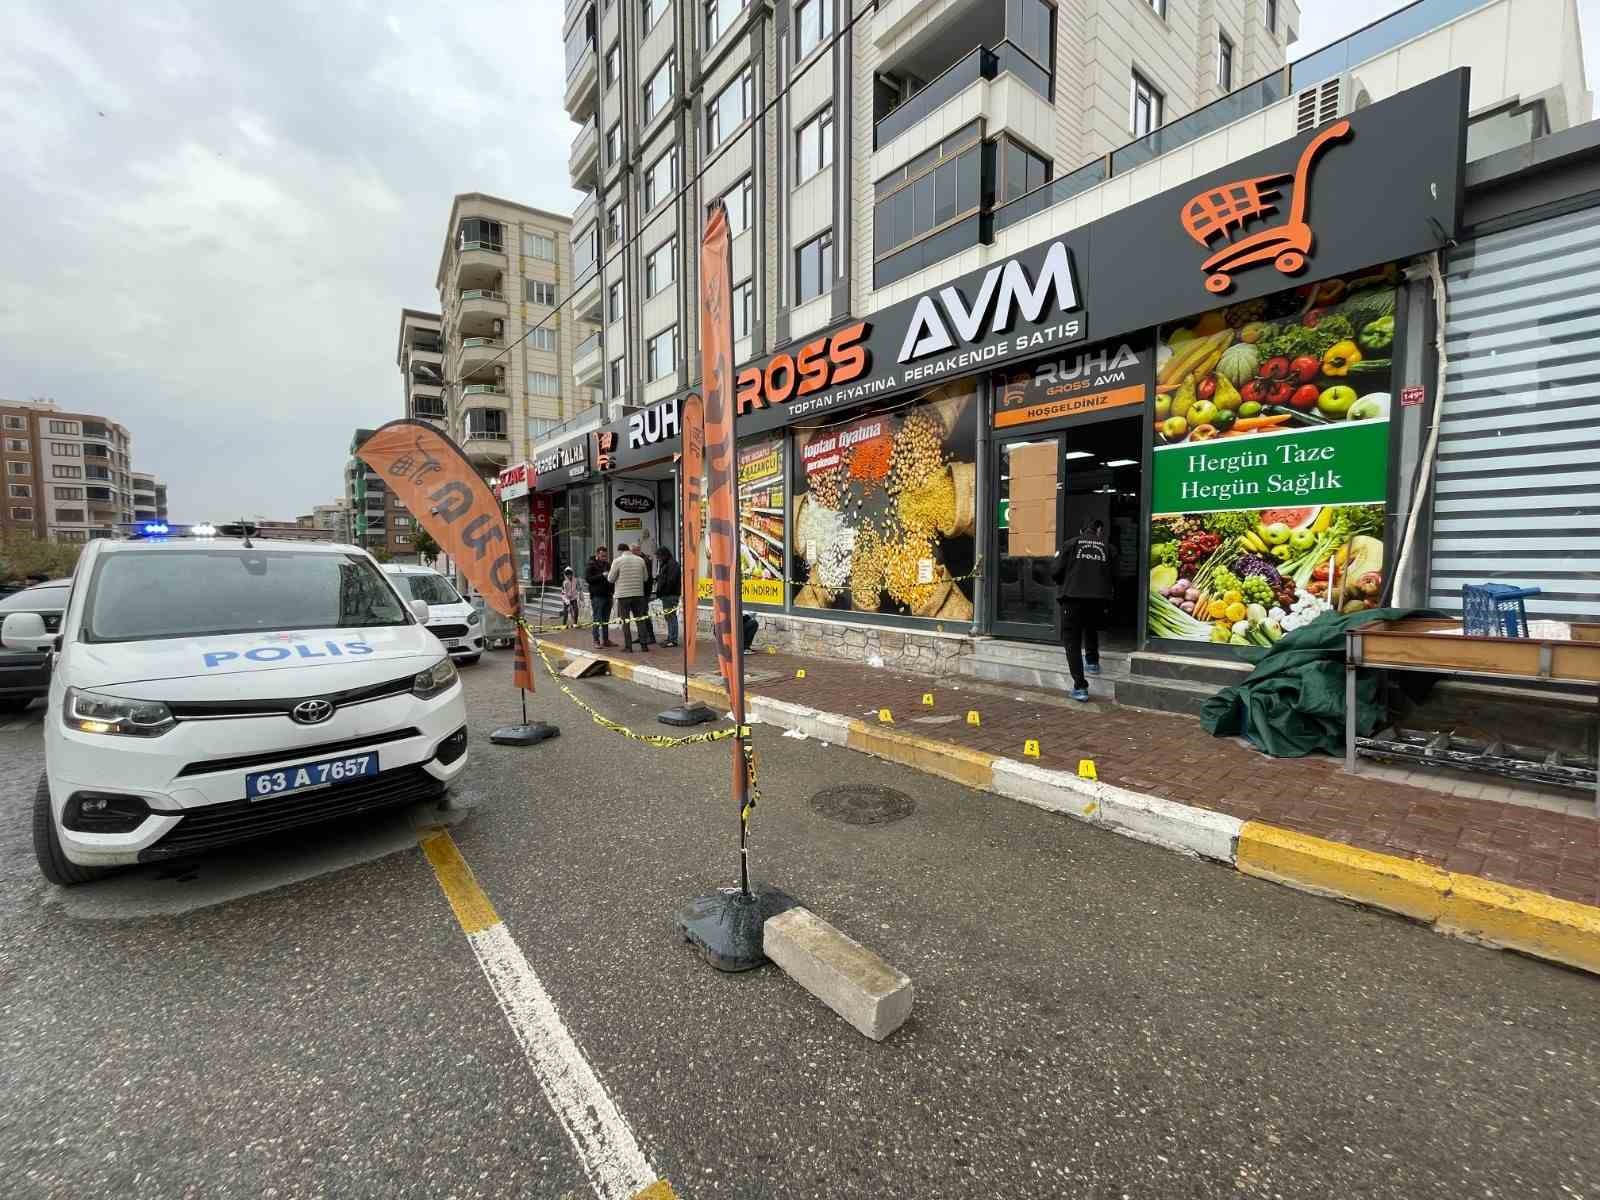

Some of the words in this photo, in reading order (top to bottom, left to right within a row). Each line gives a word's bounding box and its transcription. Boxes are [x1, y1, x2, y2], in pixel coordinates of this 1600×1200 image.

[629, 399, 681, 449] RUH
[736, 322, 866, 414] ROSS
[896, 241, 1077, 363] AVM
[788, 395, 833, 416] TOPTAN
[836, 376, 896, 402] FİYATINA
[904, 341, 1009, 383] PERAKENDE
[1015, 320, 1080, 350] SATIŞ
[1034, 343, 1140, 387] RUHA
[1046, 378, 1090, 396] GROSS
[1094, 371, 1126, 387] AVM
[1027, 396, 1109, 418] HOŞGELDİNİZ
[560, 443, 584, 466] TALHA
[804, 437, 836, 459] toptan
[1187, 451, 1268, 474] Hergün
[1275, 443, 1335, 465] Taze
[1181, 479, 1260, 501] Hergün
[1267, 469, 1344, 496] Sağlık
[201, 640, 374, 668] POLİS
[256, 771, 289, 794] 63
[293, 767, 312, 786] A
[316, 756, 371, 783] 7657
